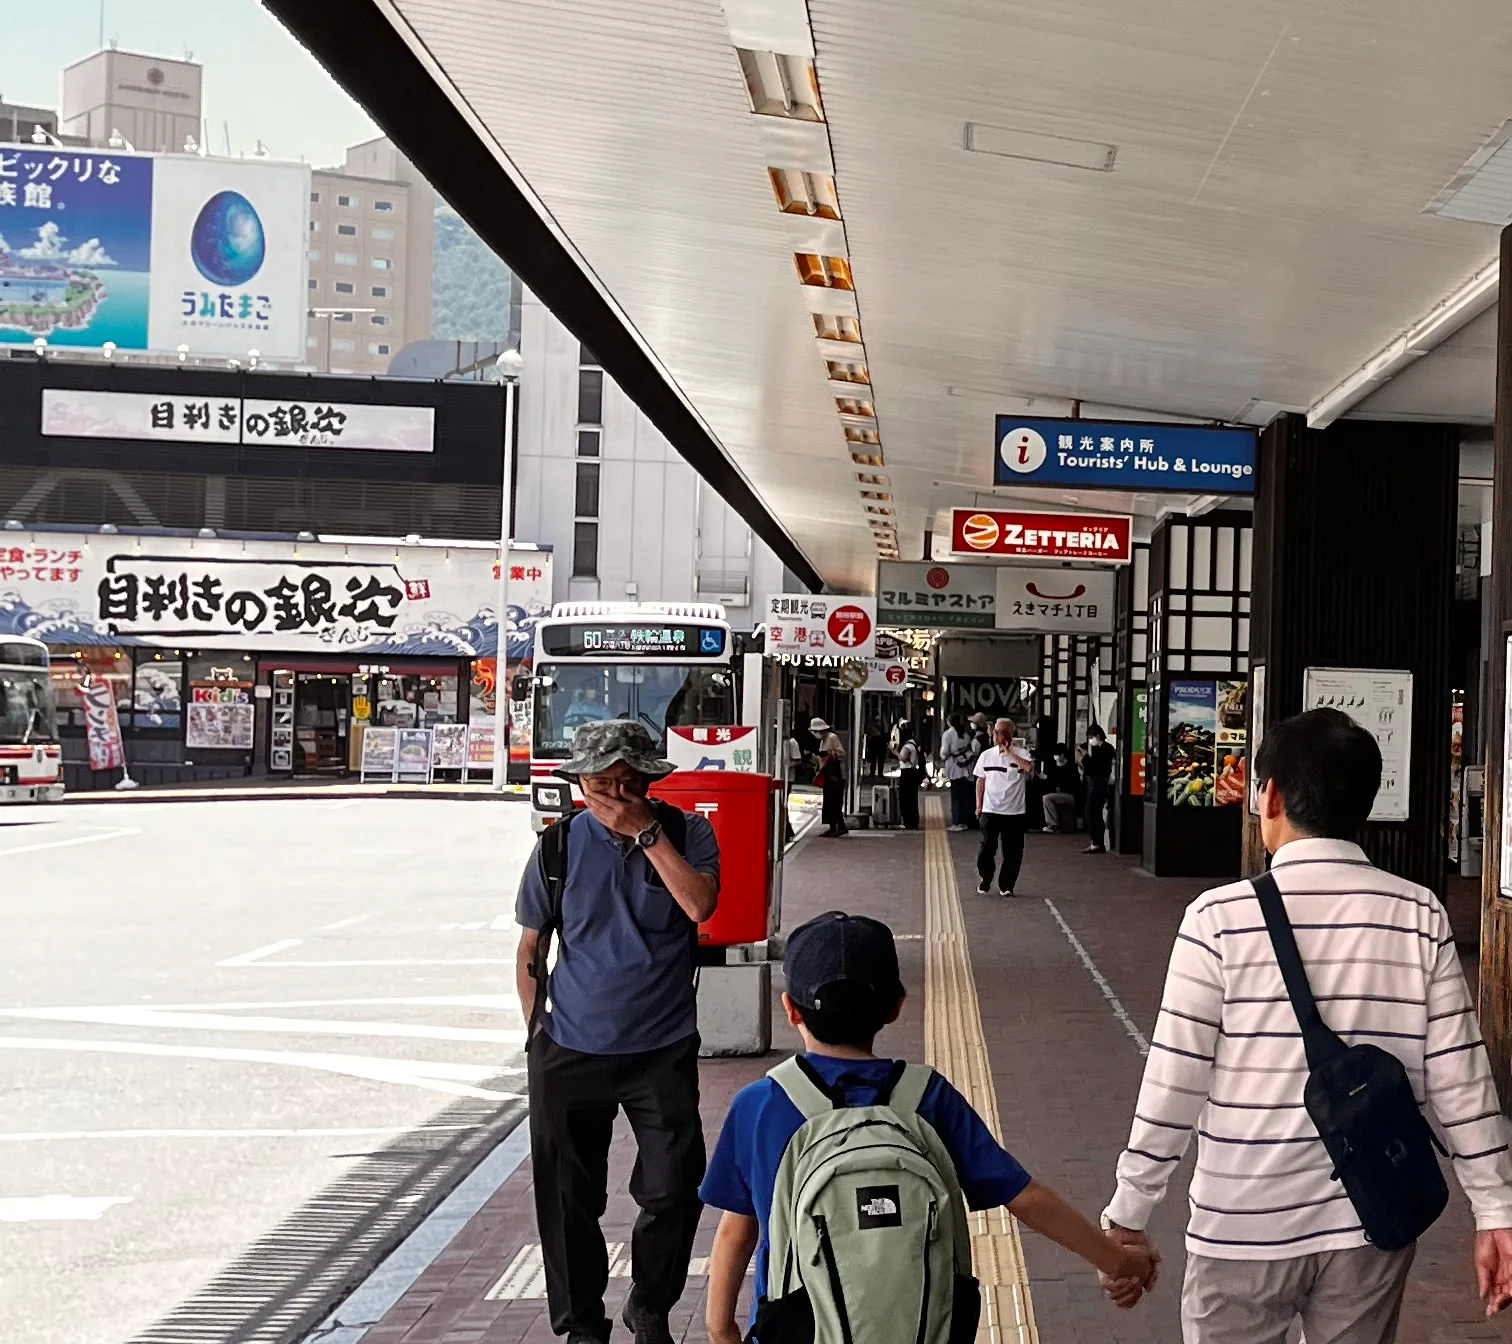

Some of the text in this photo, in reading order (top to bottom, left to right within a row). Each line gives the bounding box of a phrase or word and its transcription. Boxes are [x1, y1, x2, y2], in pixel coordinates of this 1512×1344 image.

[181, 291, 272, 321] うみたまご
[150, 400, 347, 436] 目利きの銀次
[1058, 434, 1155, 454] 観光案内所
[1134, 455, 1169, 472] Hub
[1173, 458, 1187, 472] &
[1191, 459, 1253, 478] Lounge
[1004, 523, 1120, 549] ZETTERIA
[98, 572, 403, 631] 目利きの銀次
[882, 591, 995, 609] マルミヤストア
[584, 631, 601, 649] 60
[837, 623, 857, 647] 4
[693, 728, 731, 742] 観光
